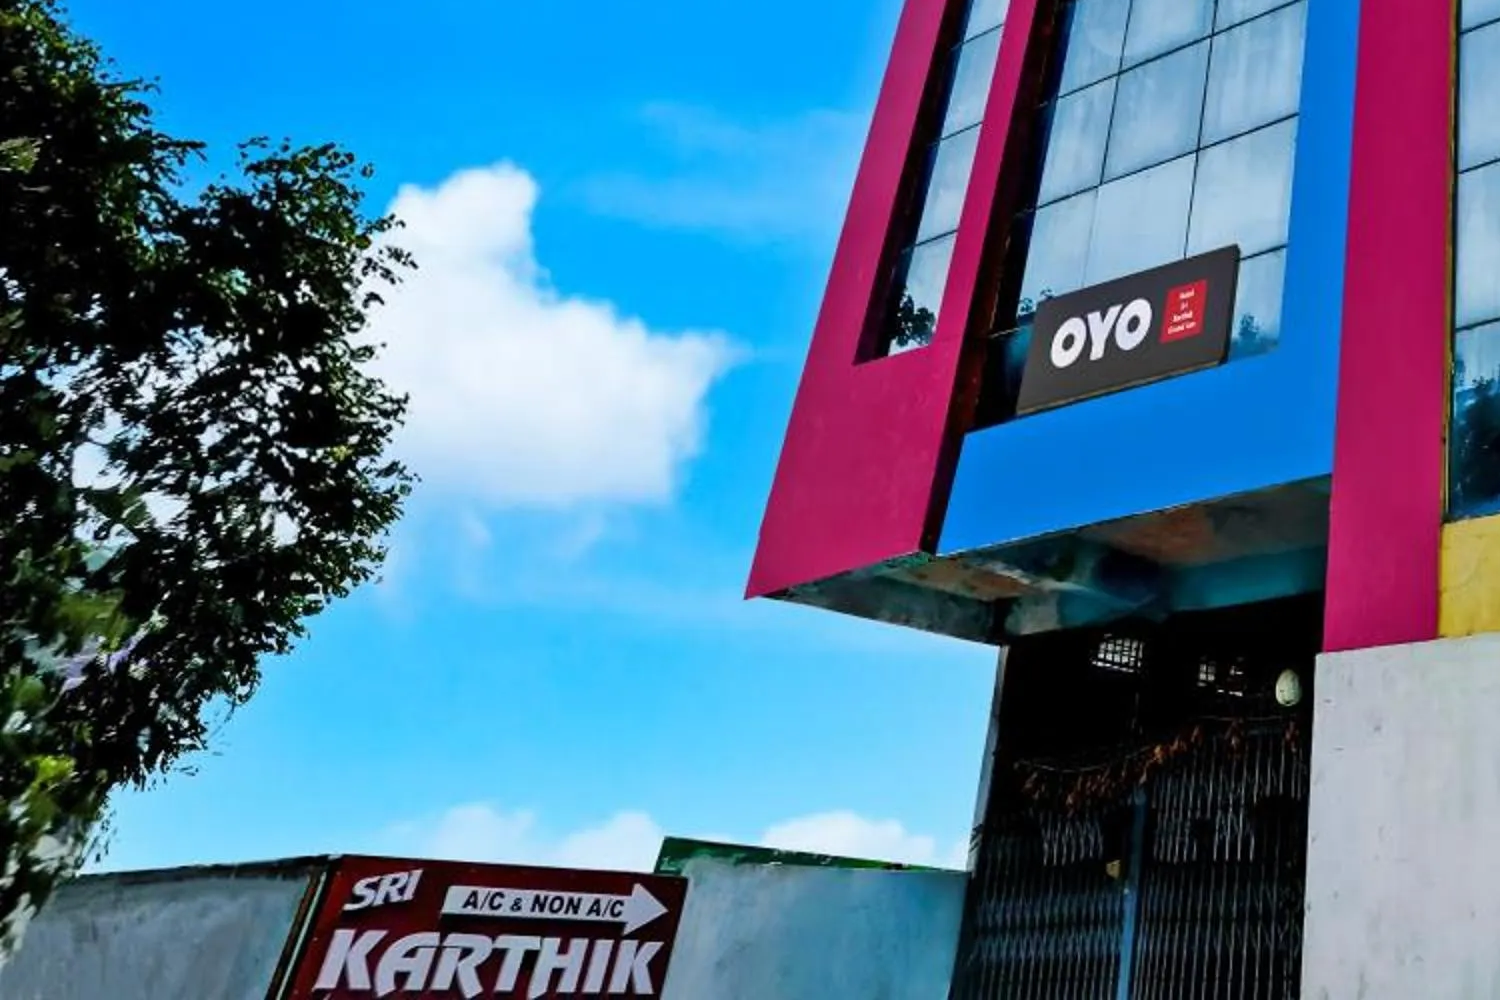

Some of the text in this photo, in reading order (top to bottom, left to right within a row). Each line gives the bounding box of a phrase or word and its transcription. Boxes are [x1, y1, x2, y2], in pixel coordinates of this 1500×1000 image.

[1050, 298, 1153, 369] OYO
[342, 868, 424, 912] SRI
[462, 889, 626, 919] A/C & NON A/C
[311, 928, 665, 1000] KARTHIK
